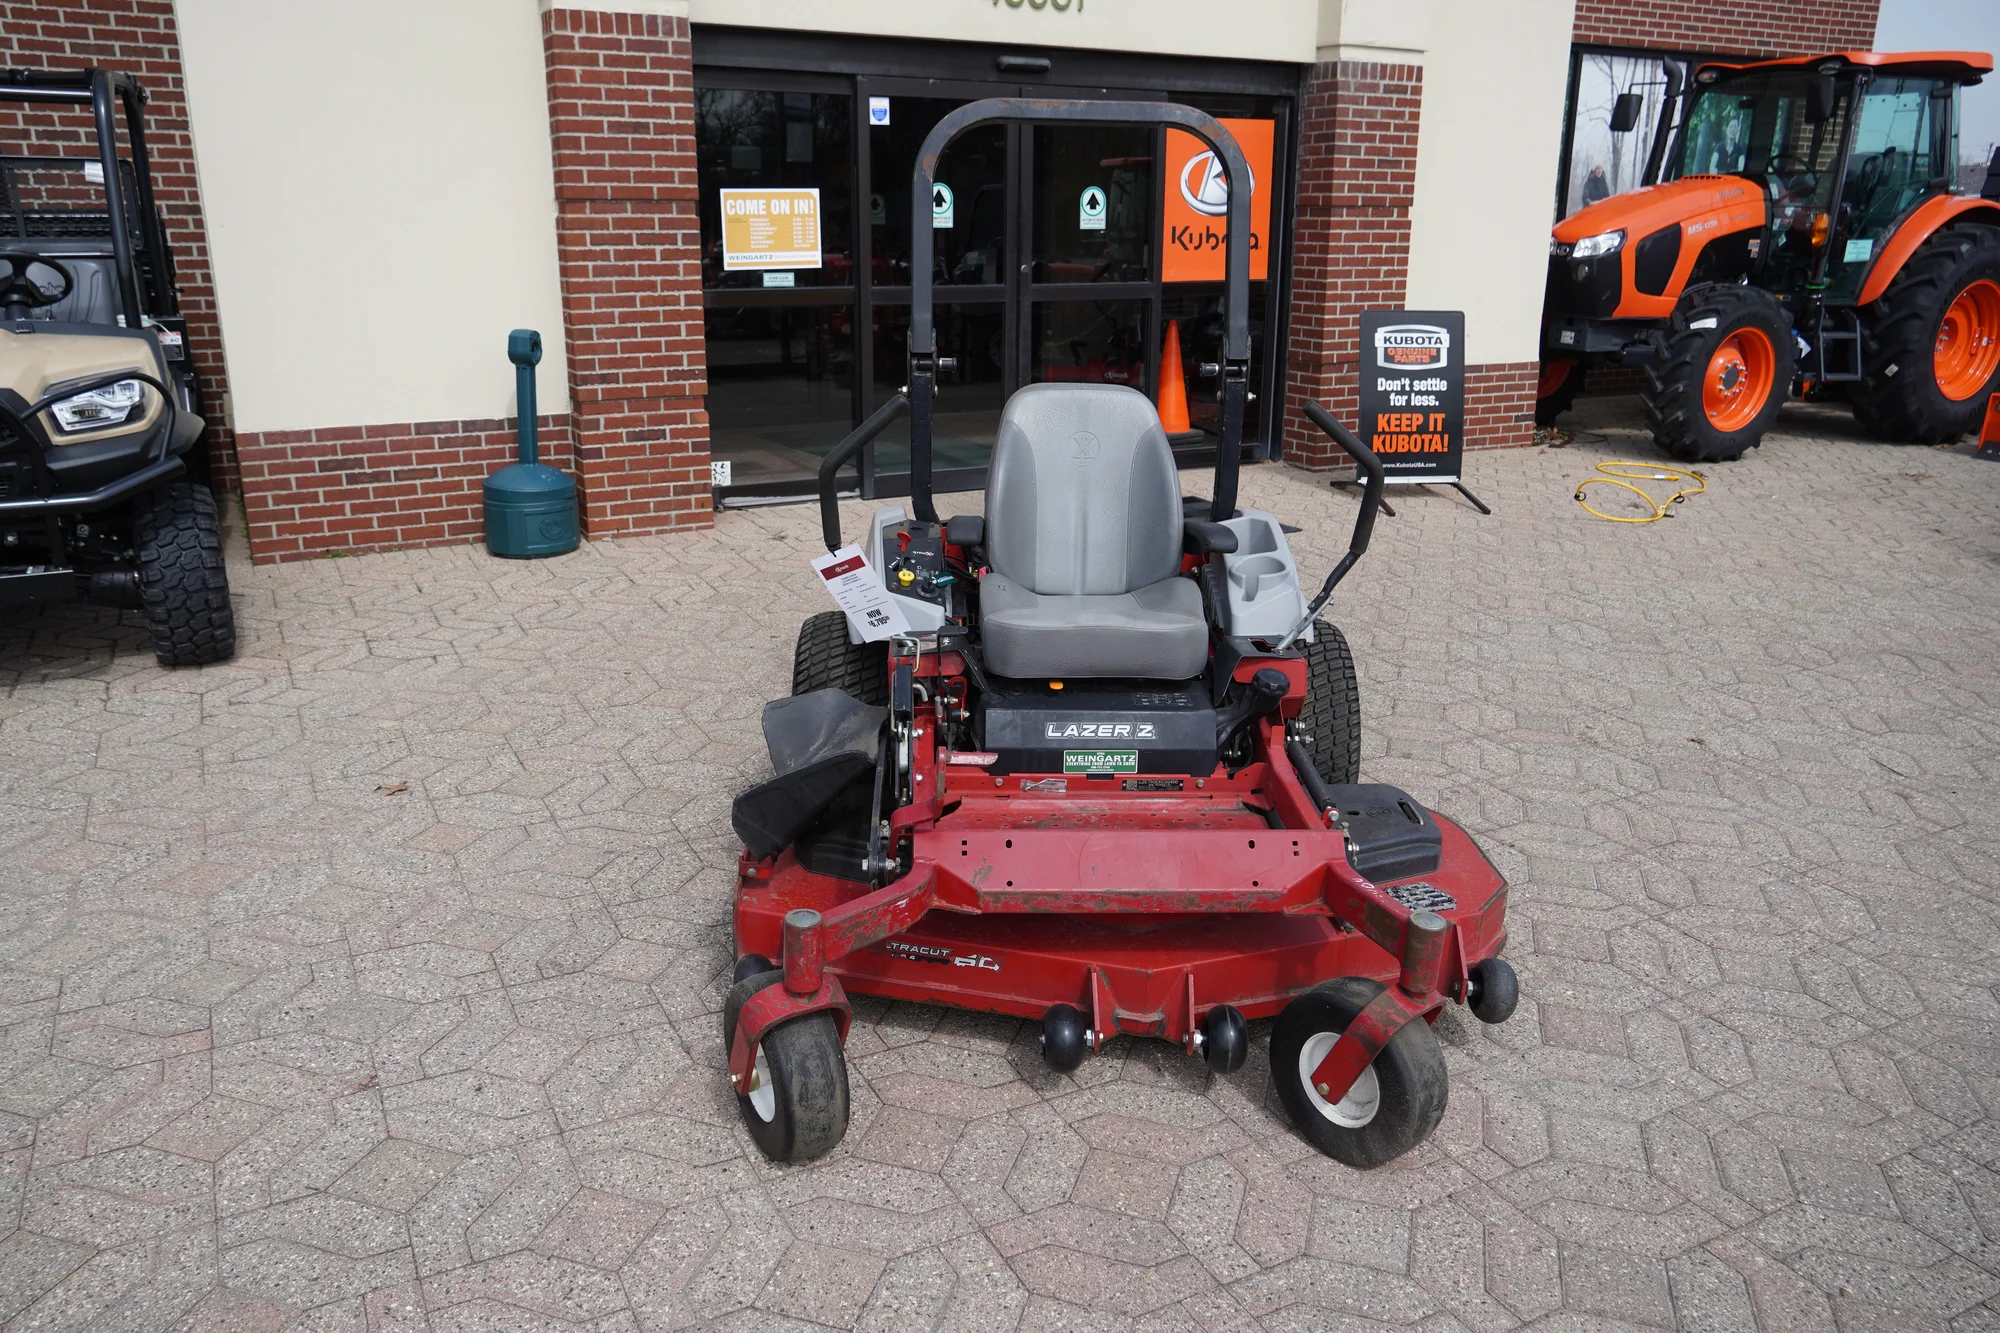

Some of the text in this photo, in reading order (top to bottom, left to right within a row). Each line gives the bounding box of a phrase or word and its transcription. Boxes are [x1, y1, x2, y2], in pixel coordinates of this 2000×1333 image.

[726, 198, 815, 216] COME ON IN!
[1171, 226, 1259, 251] Kuba
[1383, 336, 1443, 346] KUBOTA
[1387, 347, 1437, 356] GENUINE
[1394, 355, 1431, 363] PARTS
[1377, 377, 1448, 392] Don't settle
[1389, 392, 1439, 406] for less.
[1377, 413, 1446, 432] KEEP IT
[1372, 433, 1449, 453] KUBOTA!
[866, 608, 882, 619] NOW
[1046, 723, 1156, 738] LAZER Z
[886, 941, 950, 957] TRACUT
